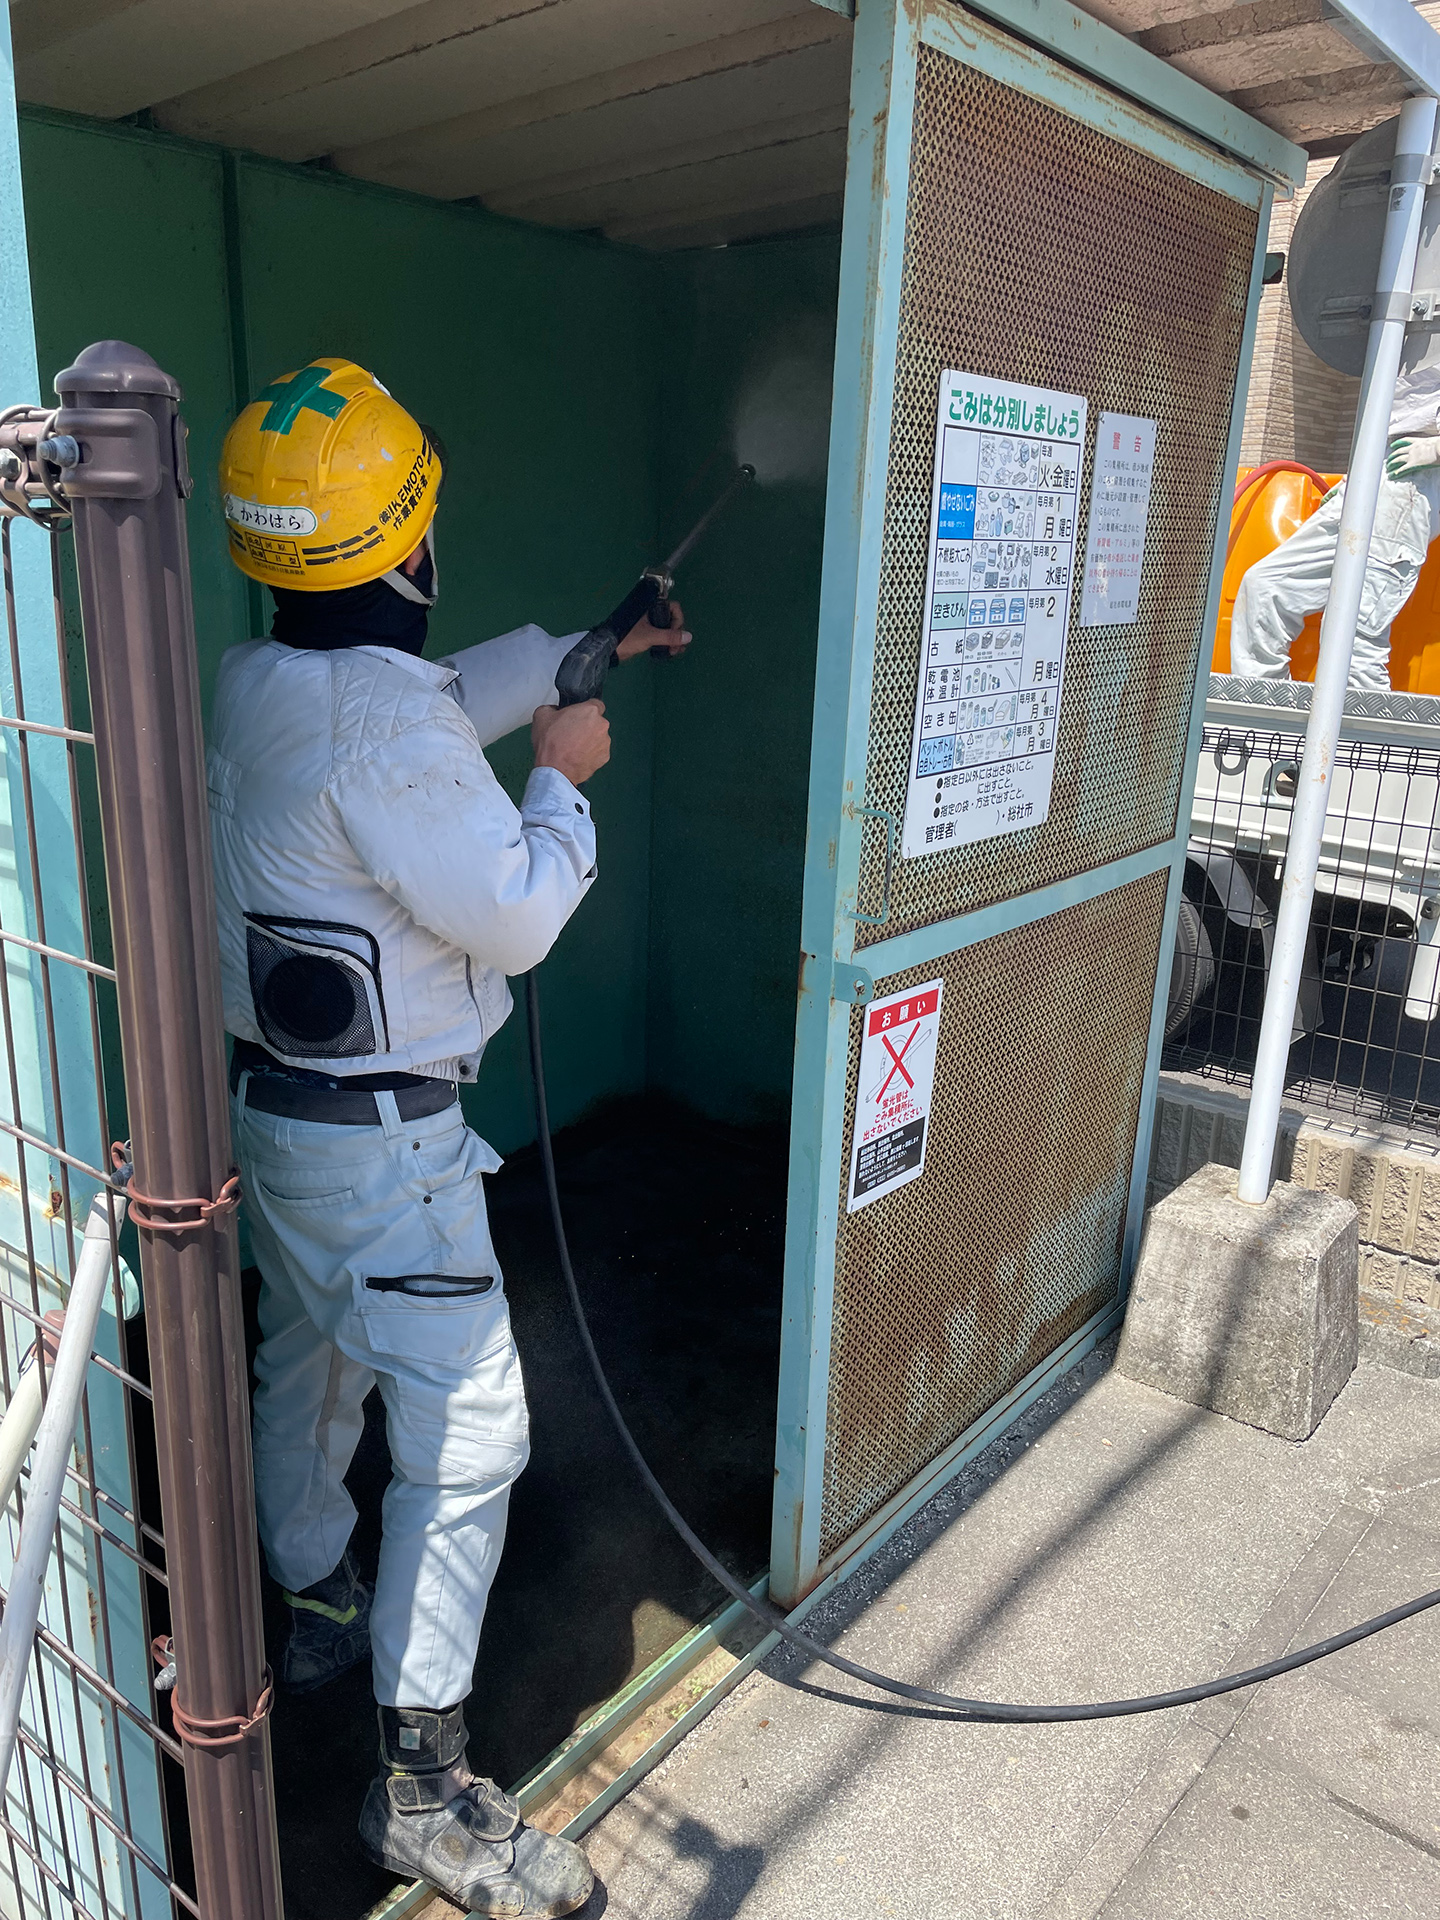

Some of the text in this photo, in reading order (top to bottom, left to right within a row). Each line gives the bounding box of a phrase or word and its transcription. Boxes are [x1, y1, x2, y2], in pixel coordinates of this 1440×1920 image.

[949, 389, 1079, 438] ごみは分別しましょう
[241, 507, 301, 530] かわはら
[1045, 566, 1067, 585] 水曜日
[933, 602, 966, 619] 空きびん
[920, 738, 953, 755] ペットボトル
[943, 759, 1034, 788] 指定日以外には出さないこと。
[977, 777, 1014, 795] に出すこと。
[940, 788, 1025, 818] 指定の袋・方法で出すこと。
[881, 1000, 926, 1028] お願い
[862, 1106, 923, 1142] 出さないでください
